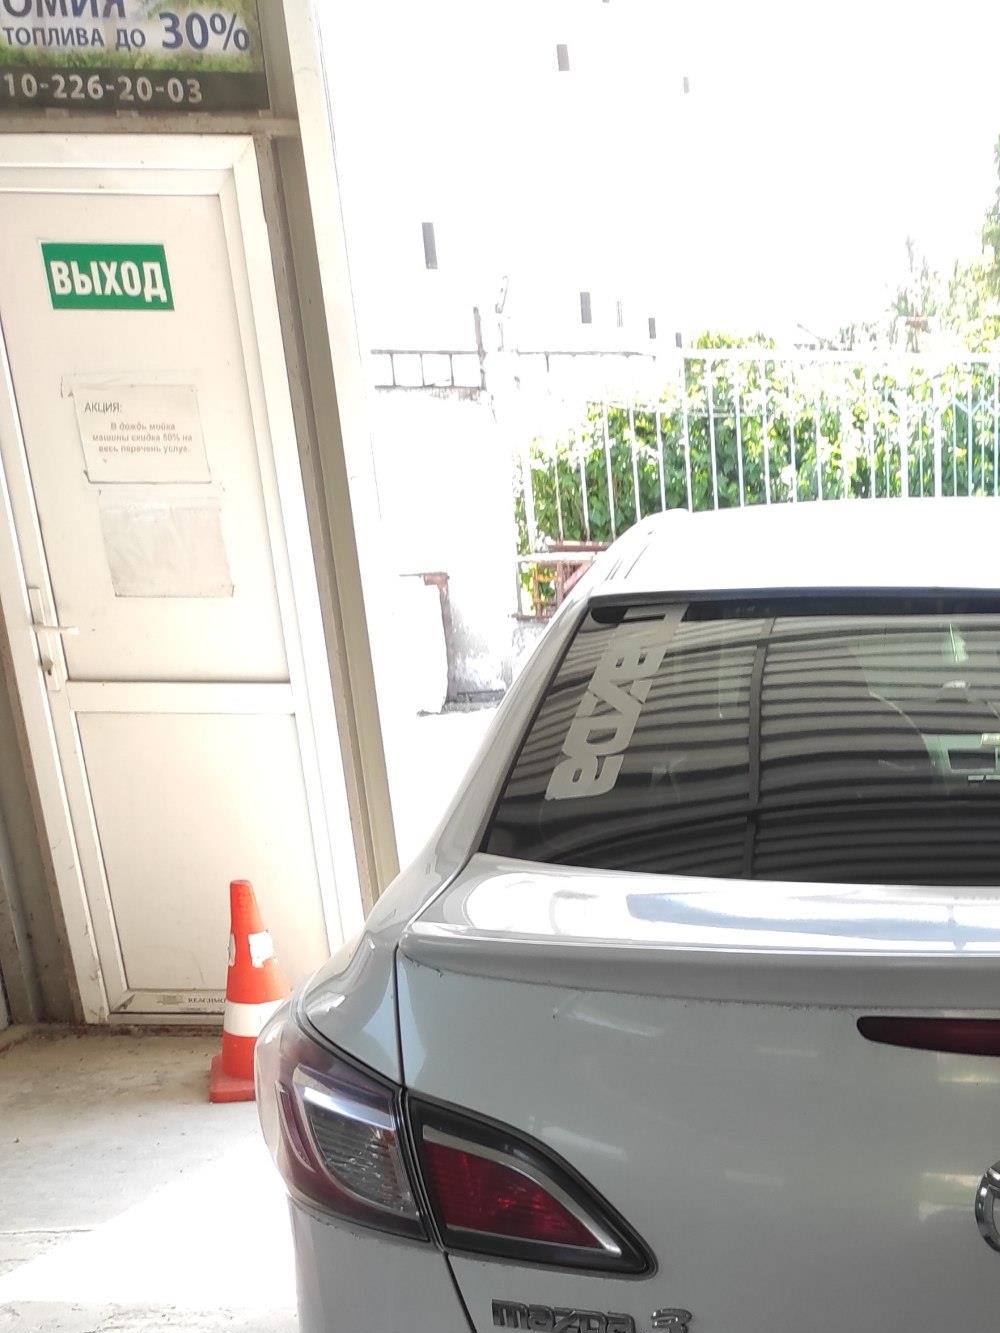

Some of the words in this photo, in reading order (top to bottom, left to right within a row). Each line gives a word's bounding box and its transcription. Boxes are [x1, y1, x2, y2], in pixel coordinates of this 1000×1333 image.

[2, 27, 104, 47] ТОПЛИВА
[116, 28, 146, 51] ДО
[159, 12, 249, 51] 30%
[50, 260, 168, 303] ВЫХОД
